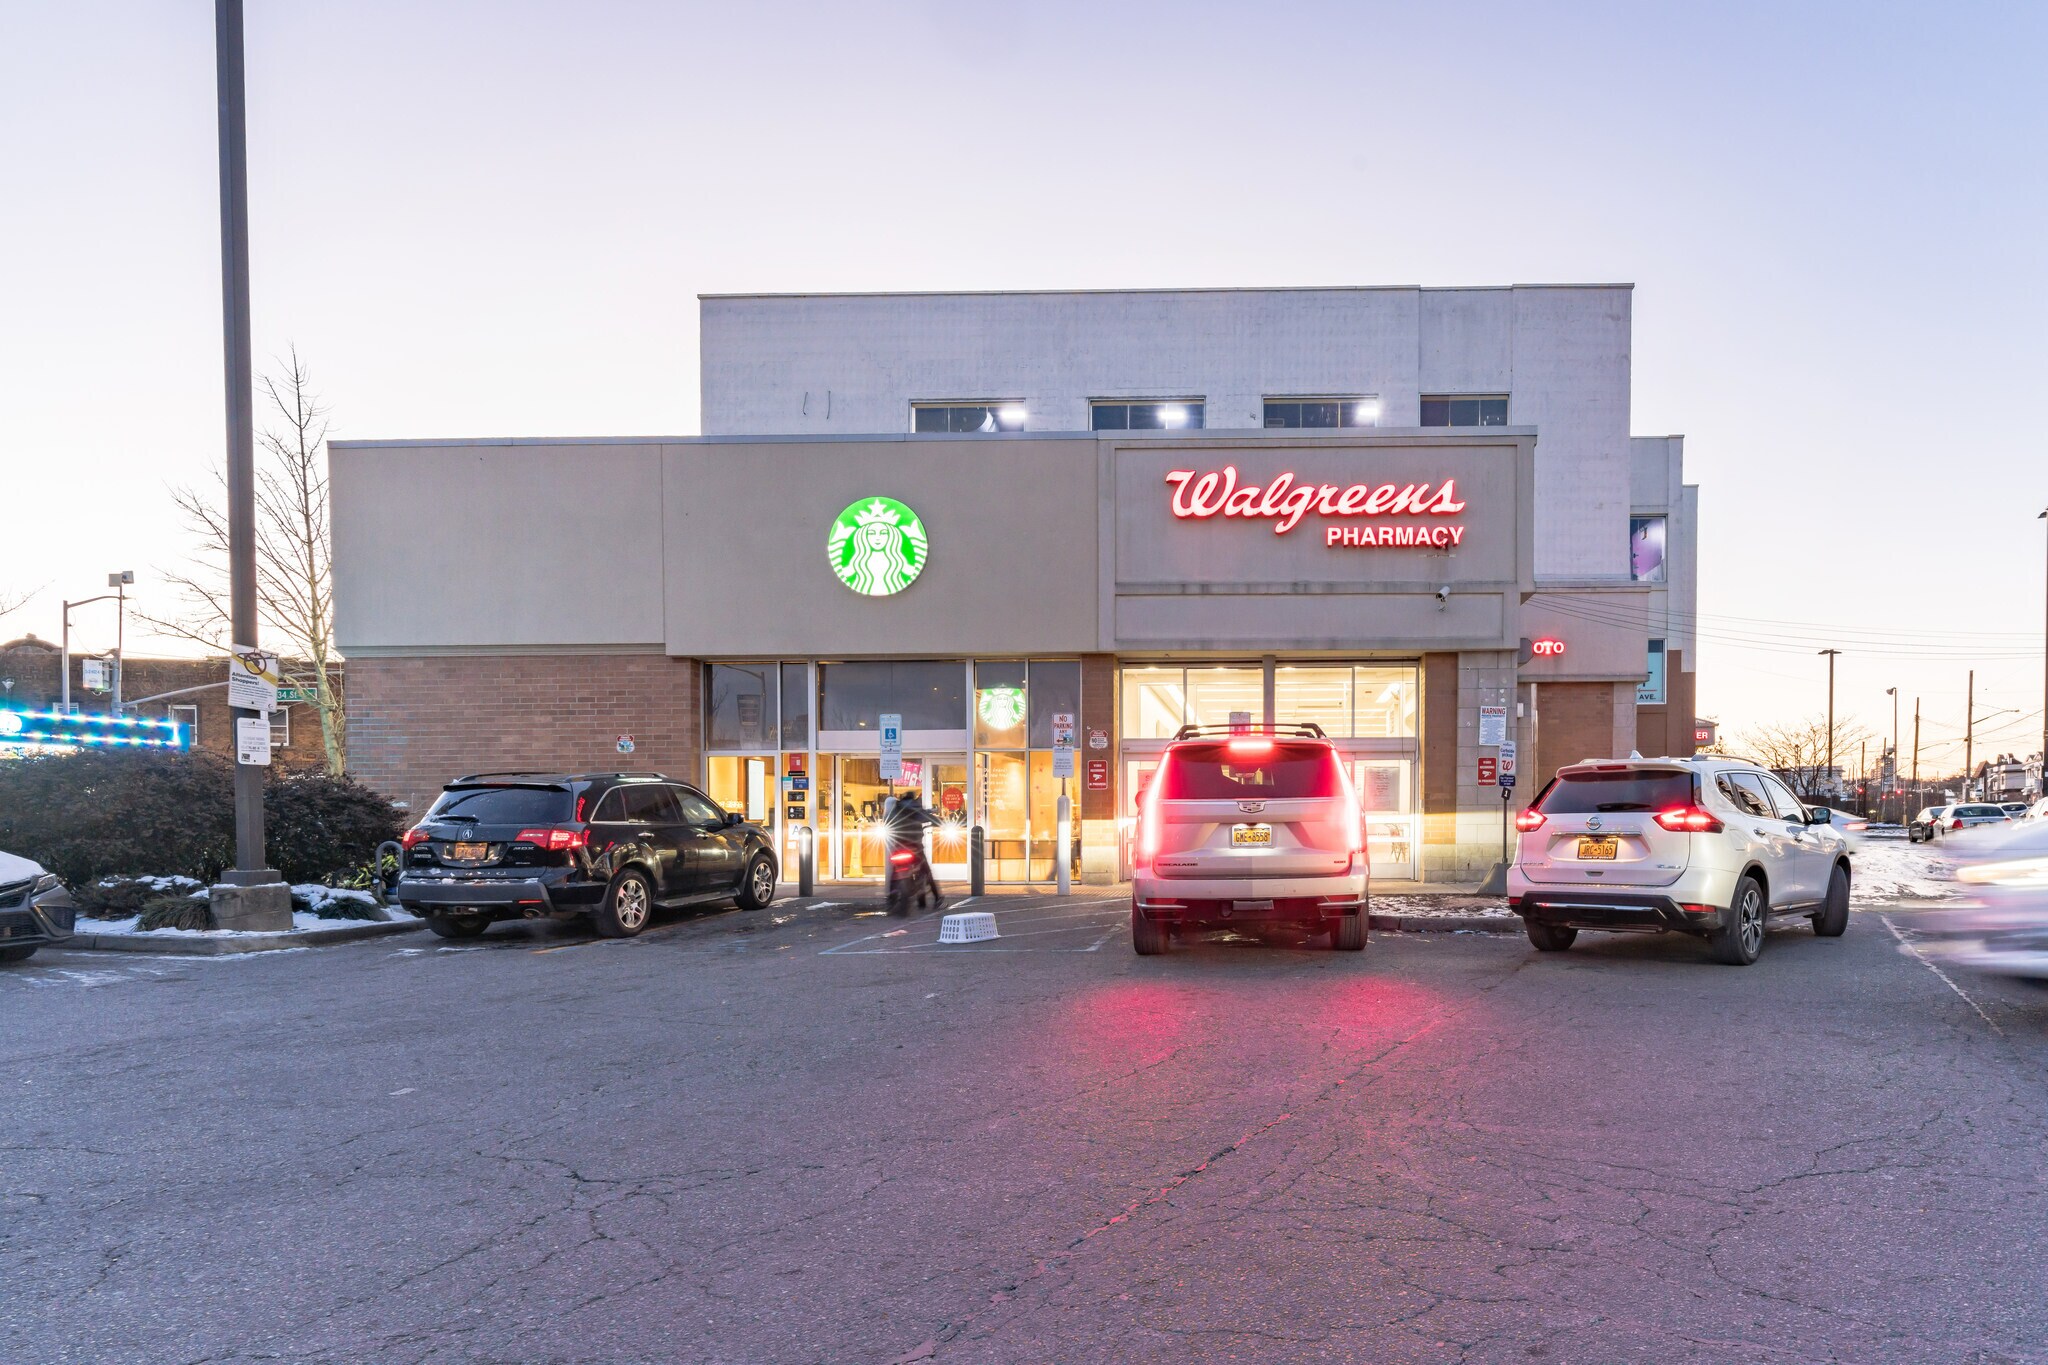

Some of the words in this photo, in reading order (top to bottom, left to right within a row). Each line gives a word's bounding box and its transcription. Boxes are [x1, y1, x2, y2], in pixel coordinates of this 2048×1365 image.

[1166, 466, 1466, 534] Walgreens
[1327, 526, 1465, 547] PHARMACY
[232, 672, 258, 680] Attention
[232, 677, 260, 685] Shoppers!
[1481, 707, 1506, 715] WARNING
[1696, 731, 1708, 740] ER
